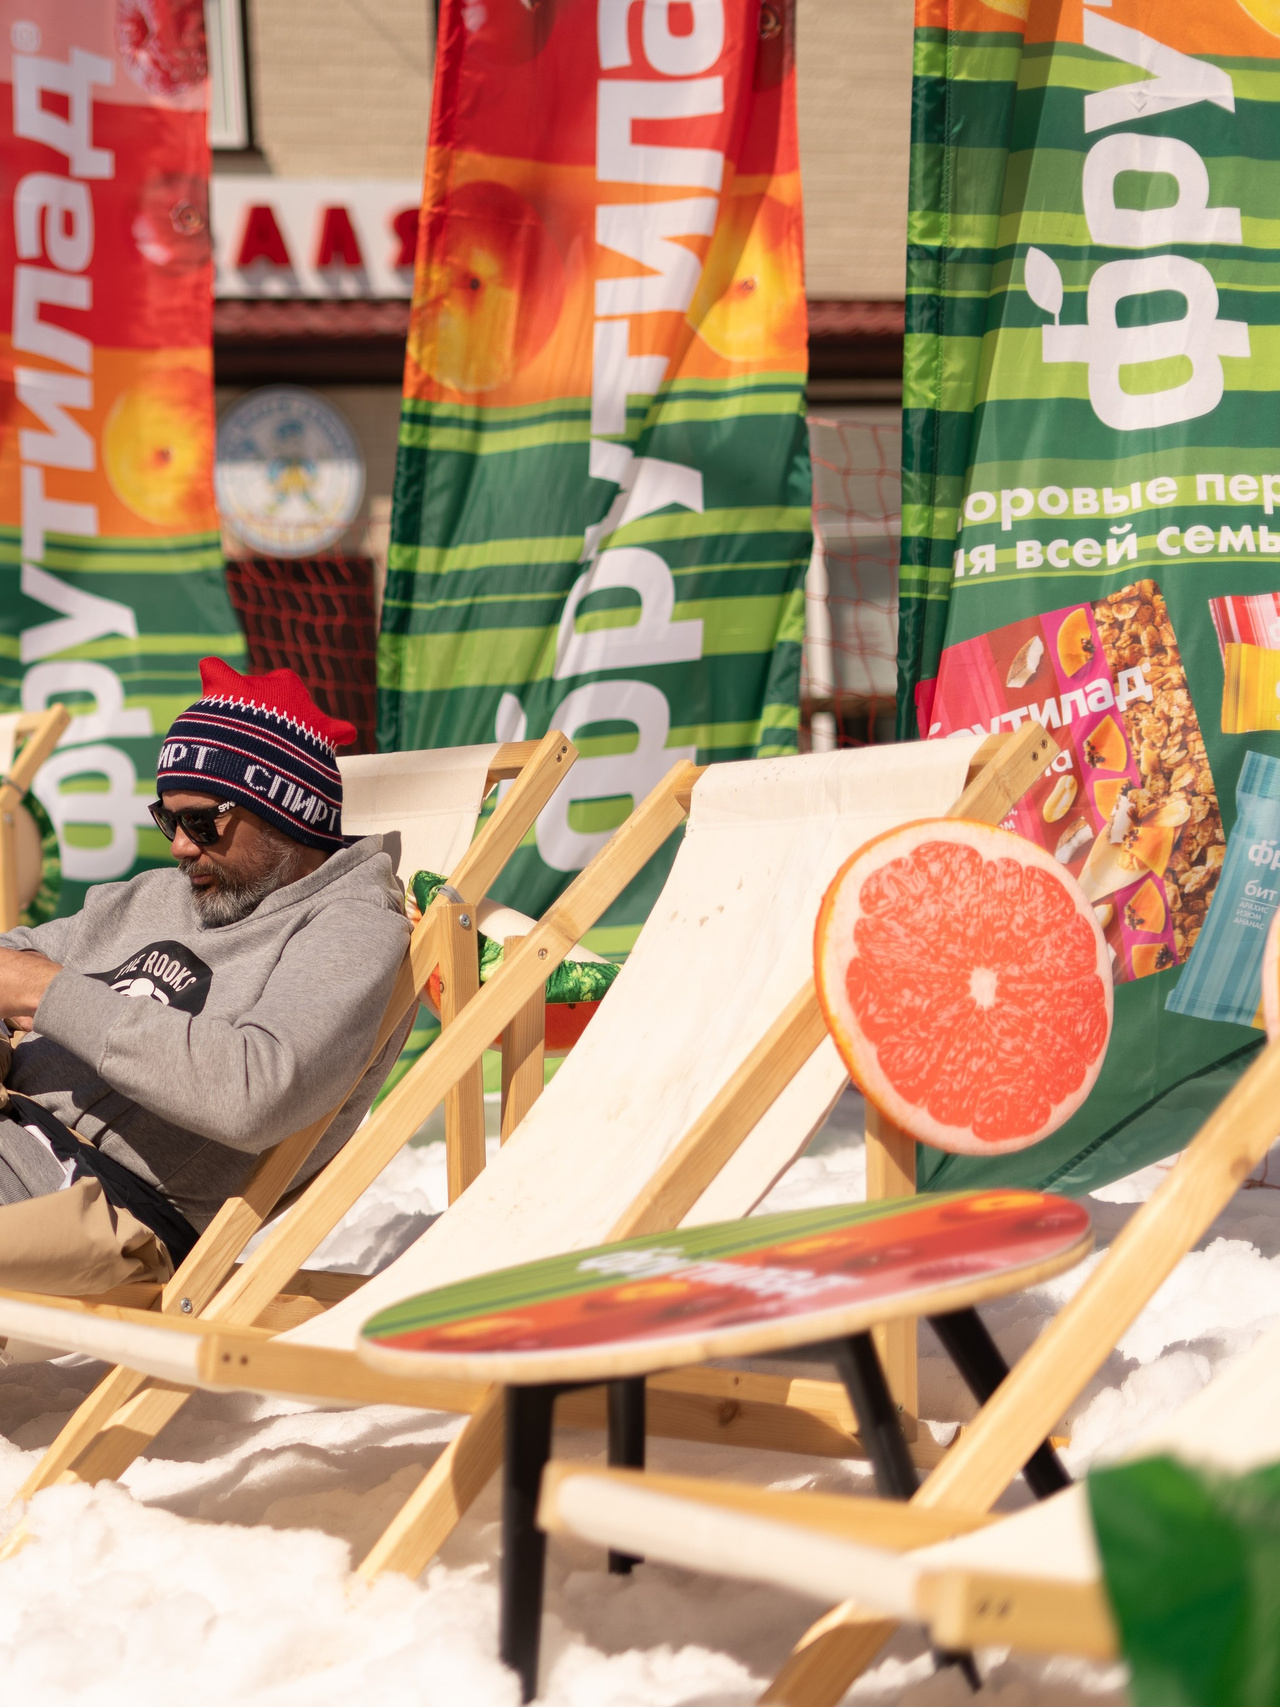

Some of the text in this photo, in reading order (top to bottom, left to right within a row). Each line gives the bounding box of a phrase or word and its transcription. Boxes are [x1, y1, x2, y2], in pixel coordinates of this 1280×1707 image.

[1024, 0, 1252, 431] фру
[958, 476, 1178, 532] оровые
[1016, 523, 1138, 570] всей
[244, 764, 340, 832] СПИРТ
[1233, 917, 1264, 930] АНАНАС
[1239, 901, 1269, 914] АРАХИС
[114, 950, 197, 992] THE ROOKS
